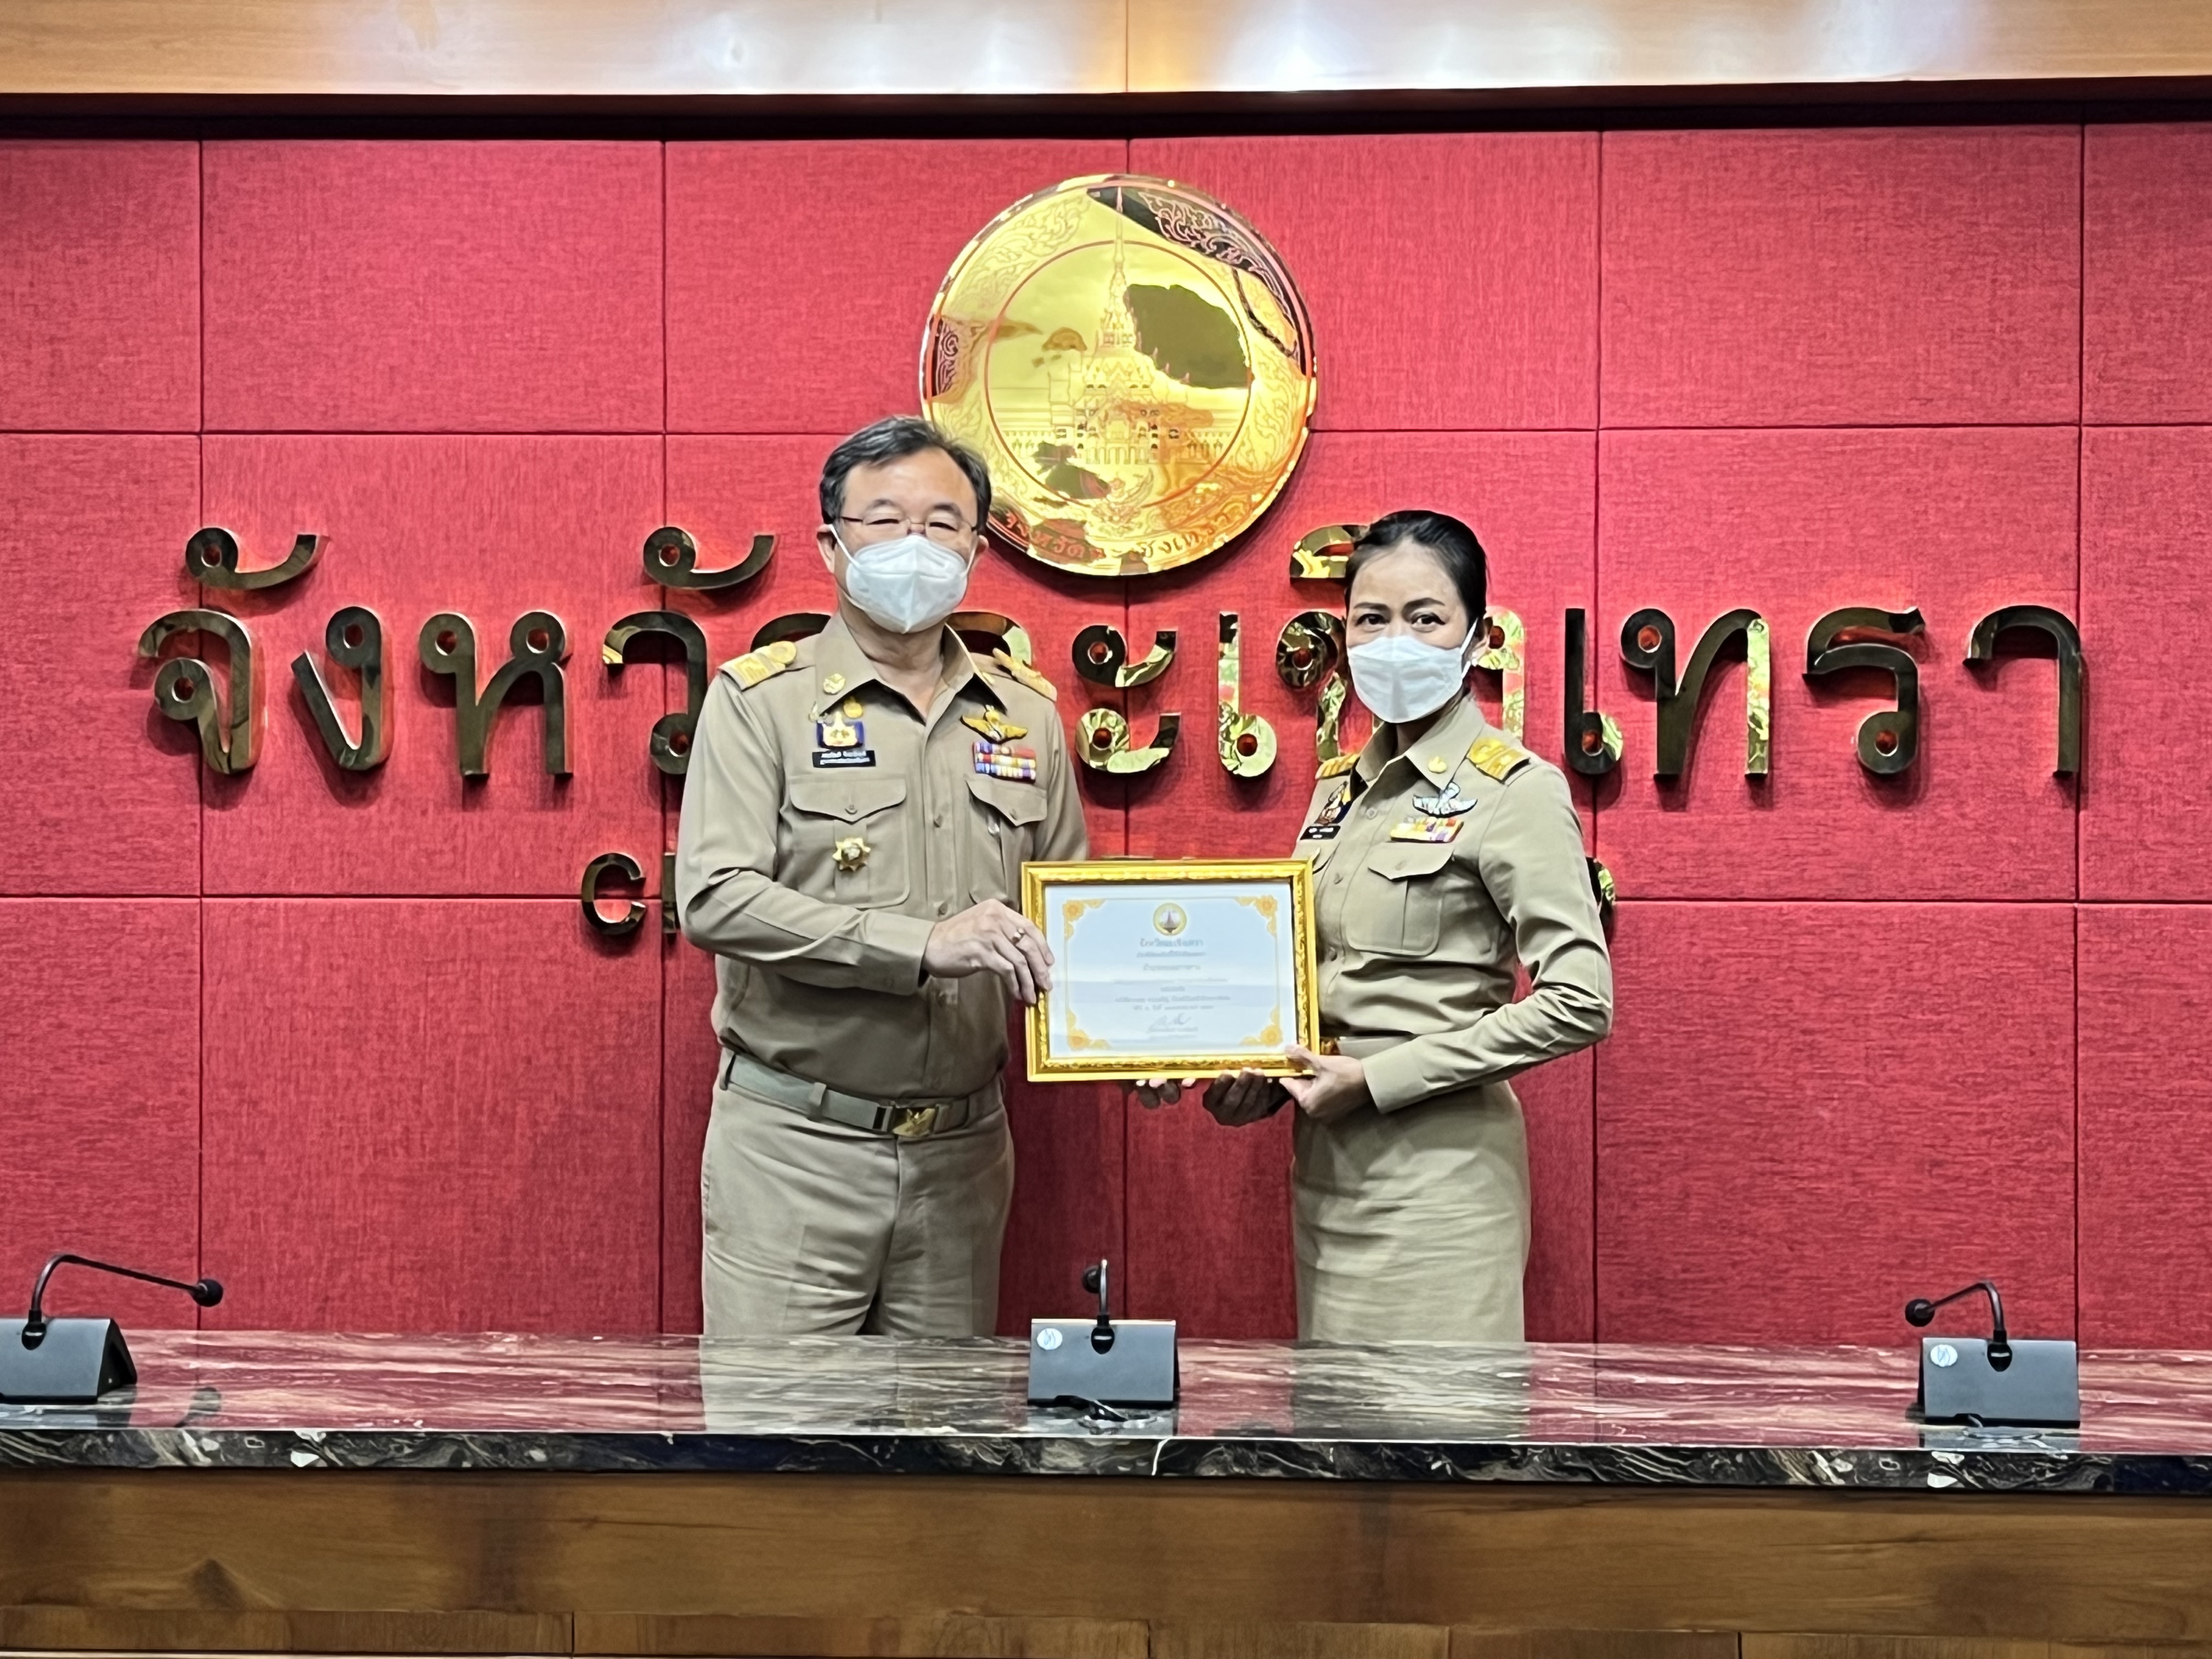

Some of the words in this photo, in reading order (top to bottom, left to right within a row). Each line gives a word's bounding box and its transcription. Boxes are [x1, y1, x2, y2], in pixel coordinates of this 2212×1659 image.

[138, 525, 2079, 777] จังหวัะเชิงเทรา
